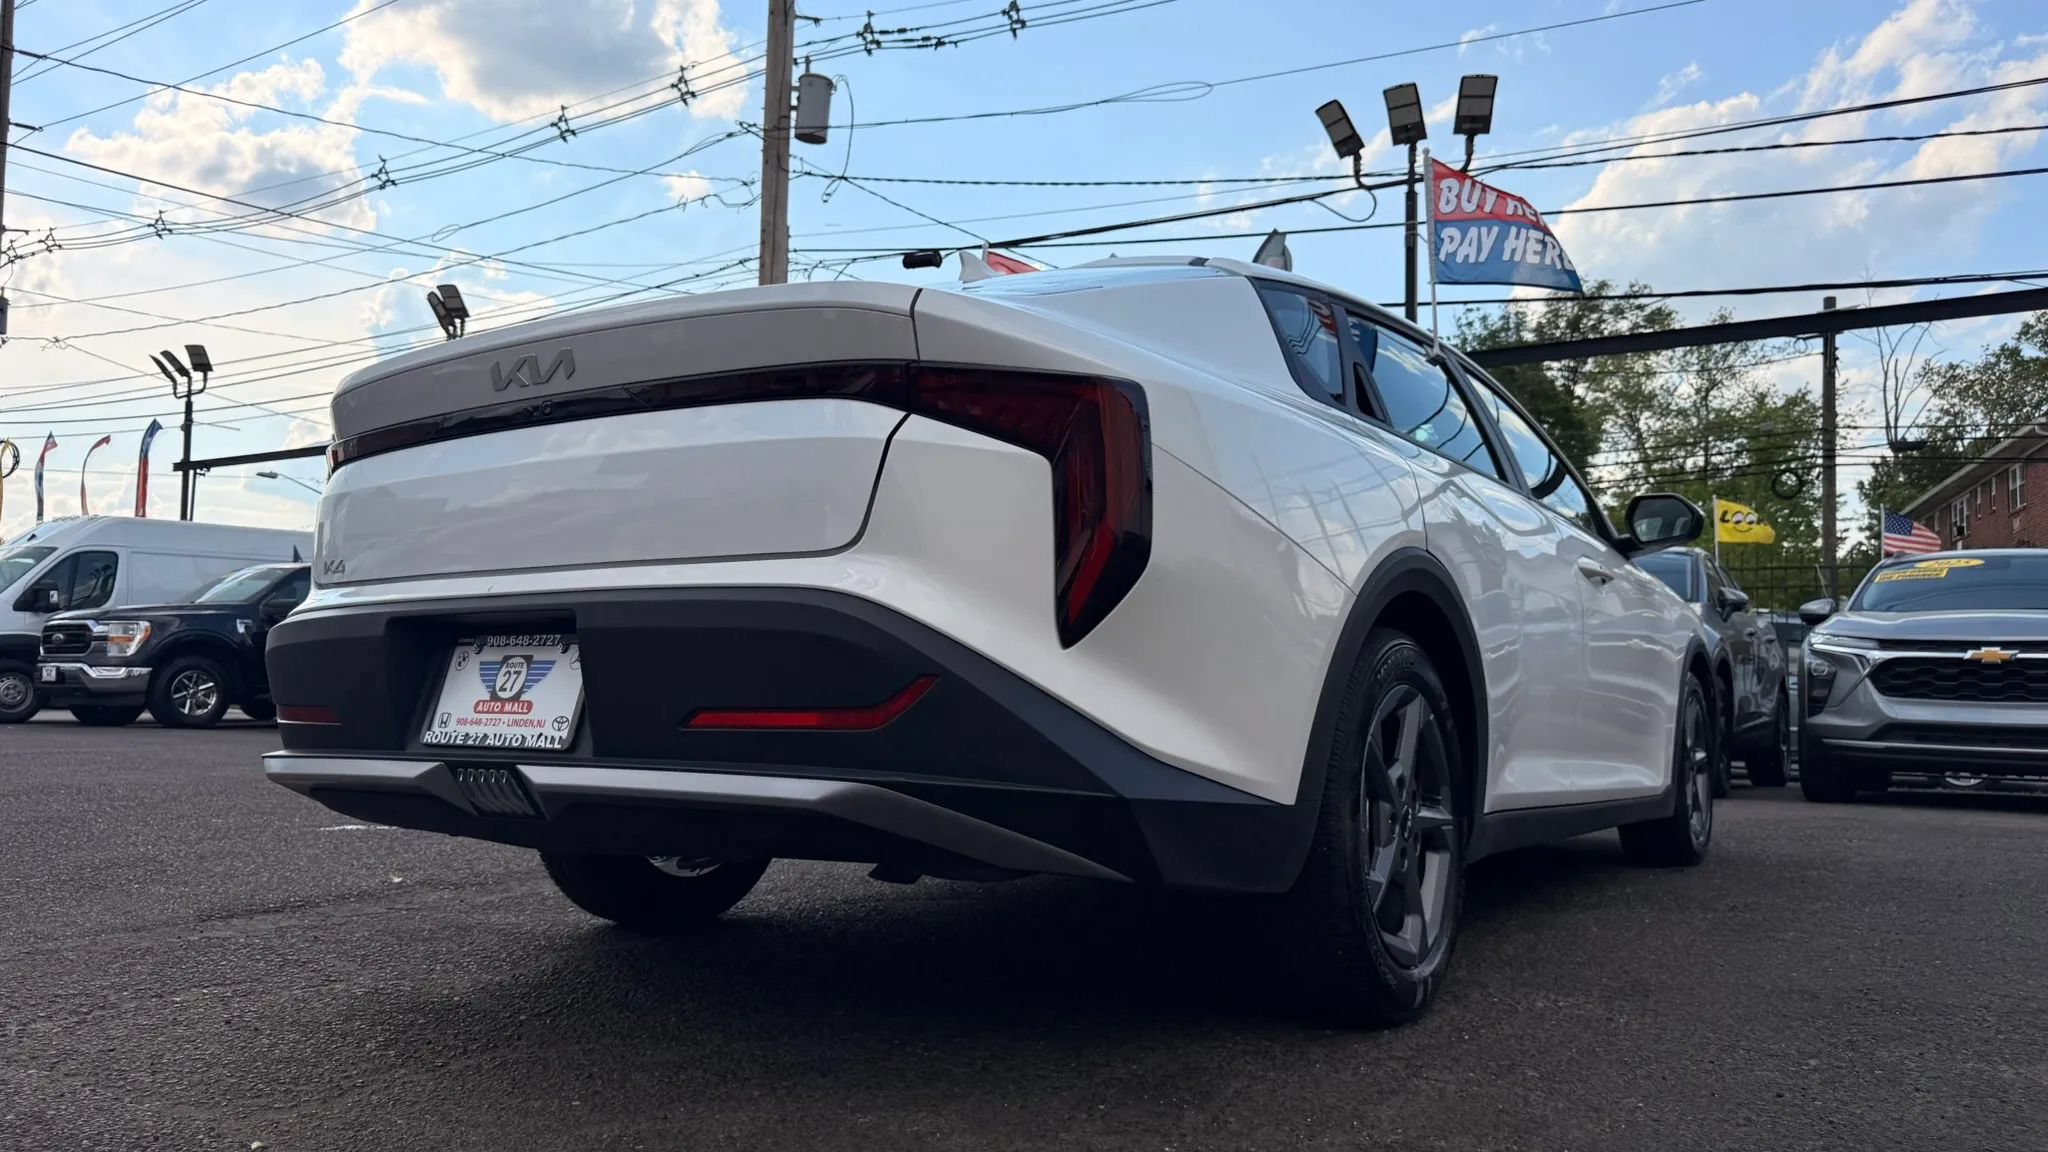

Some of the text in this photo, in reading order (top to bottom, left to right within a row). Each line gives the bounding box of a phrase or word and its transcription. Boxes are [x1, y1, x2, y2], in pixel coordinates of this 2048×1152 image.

[1438, 177, 1499, 214] BUY
[1438, 225, 1499, 263] PAY
[490, 347, 575, 391] KIA
[323, 559, 346, 575] K4
[505, 661, 526, 669] ROUTE
[498, 670, 522, 692] 27
[476, 701, 529, 713] AUTO MALL
[455, 718, 502, 727] 908-648-2727
[423, 730, 562, 748] ROUTE 27 AUTO MALL
